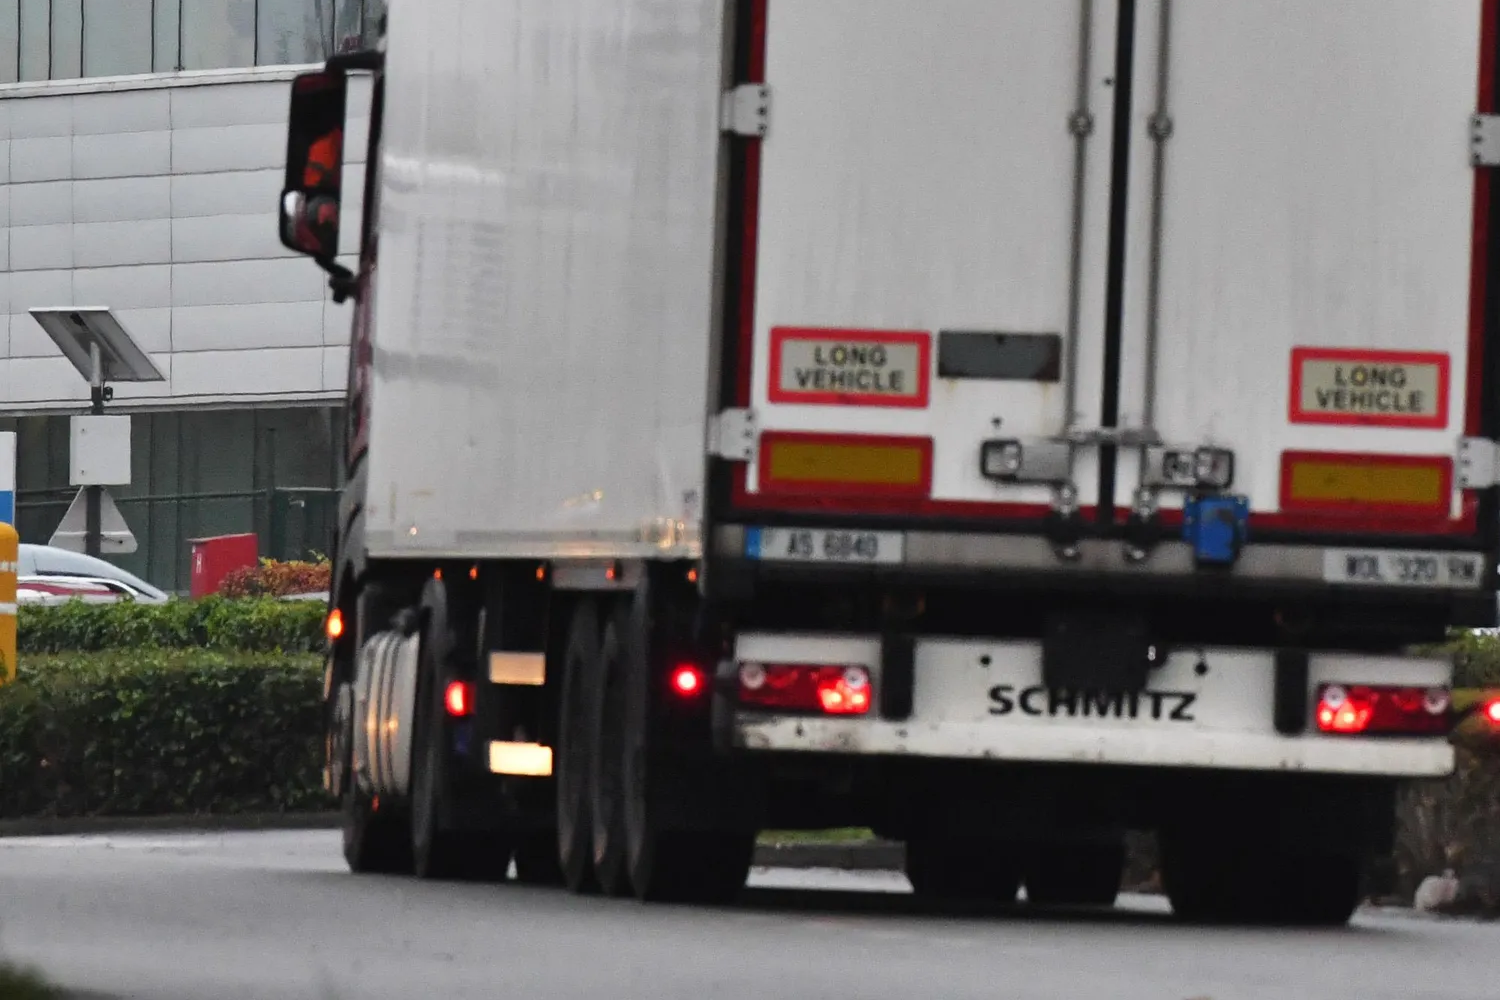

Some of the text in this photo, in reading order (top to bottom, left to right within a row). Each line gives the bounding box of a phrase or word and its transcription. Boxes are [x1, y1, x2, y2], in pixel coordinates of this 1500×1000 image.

[814, 344, 888, 367] LONG
[795, 367, 905, 392] VEHICLE
[1334, 365, 1407, 389] LONG
[1315, 387, 1424, 413] VEHICLE
[987, 684, 1197, 721] SCHMITZ
